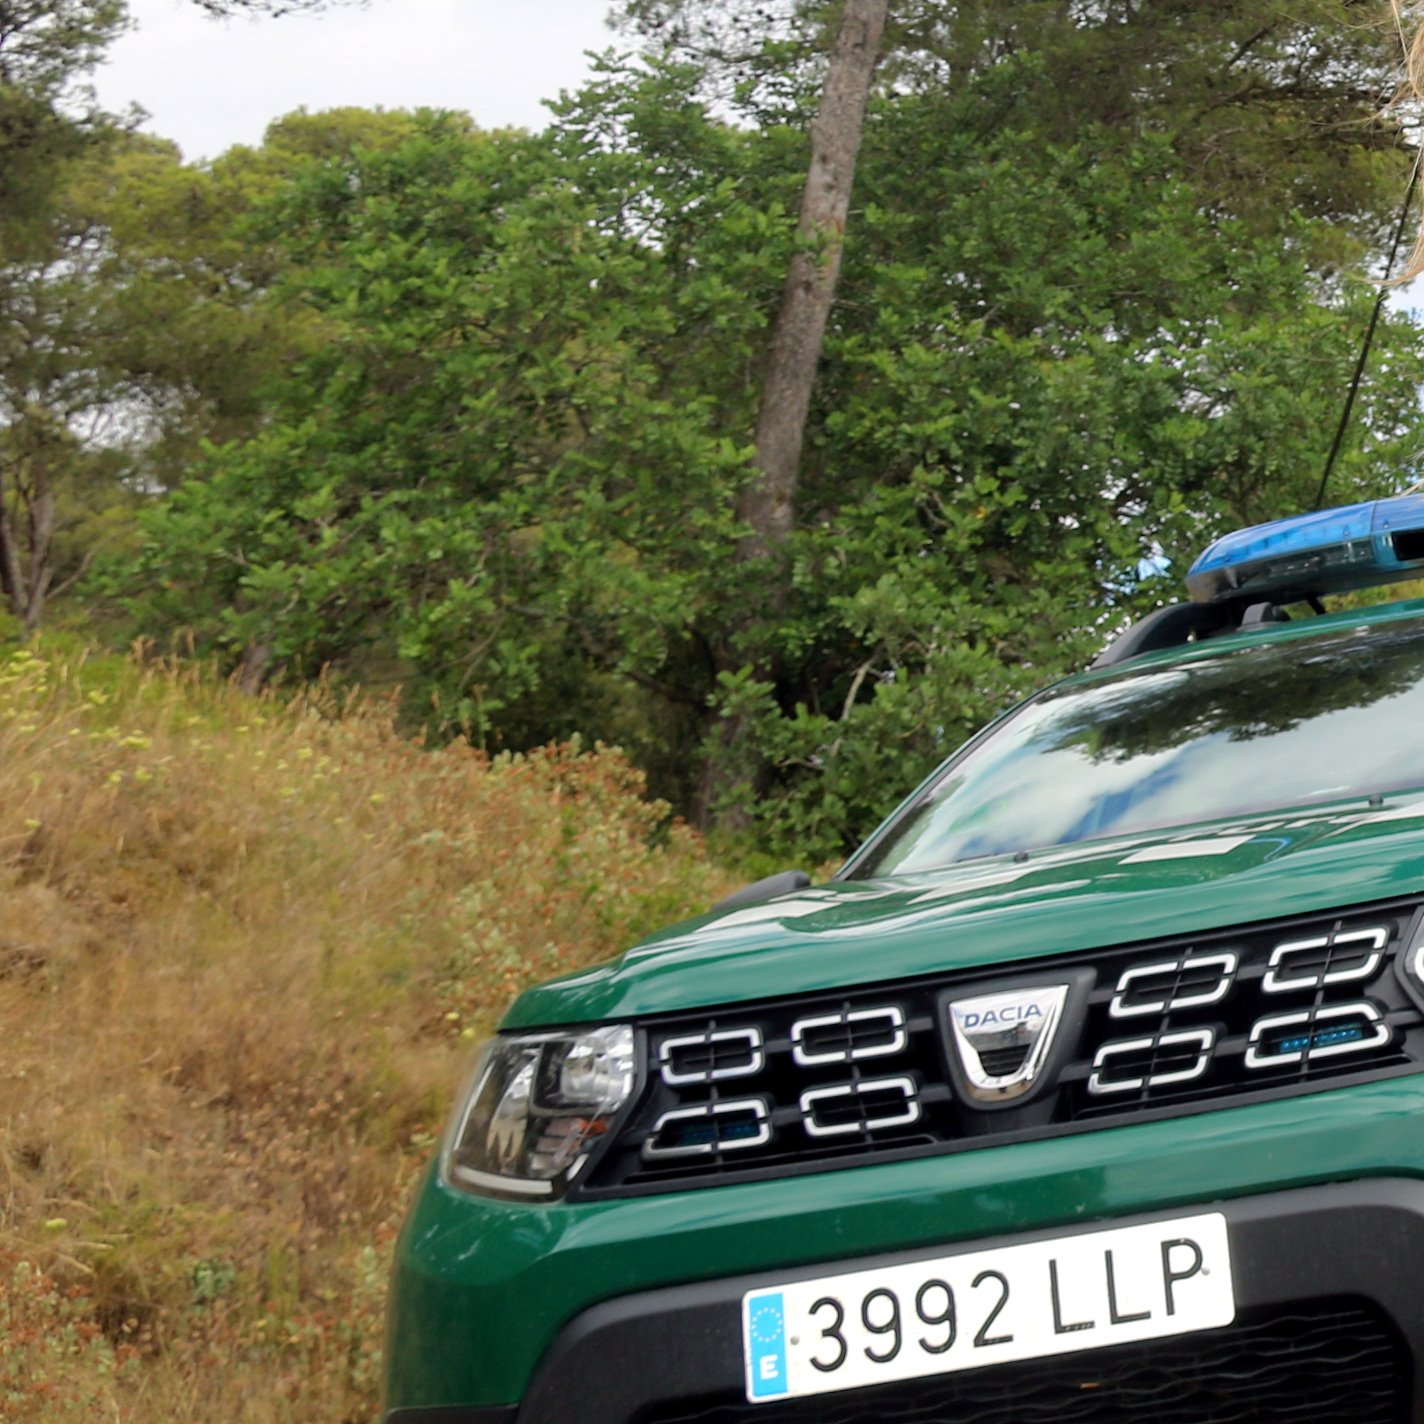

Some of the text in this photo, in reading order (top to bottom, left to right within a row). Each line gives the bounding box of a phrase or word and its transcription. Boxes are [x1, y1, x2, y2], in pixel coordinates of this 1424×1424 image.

[964, 1004, 1042, 1028] DACIA
[809, 1238, 1204, 1372] 3992 LLP
[760, 1354, 778, 1379] E
